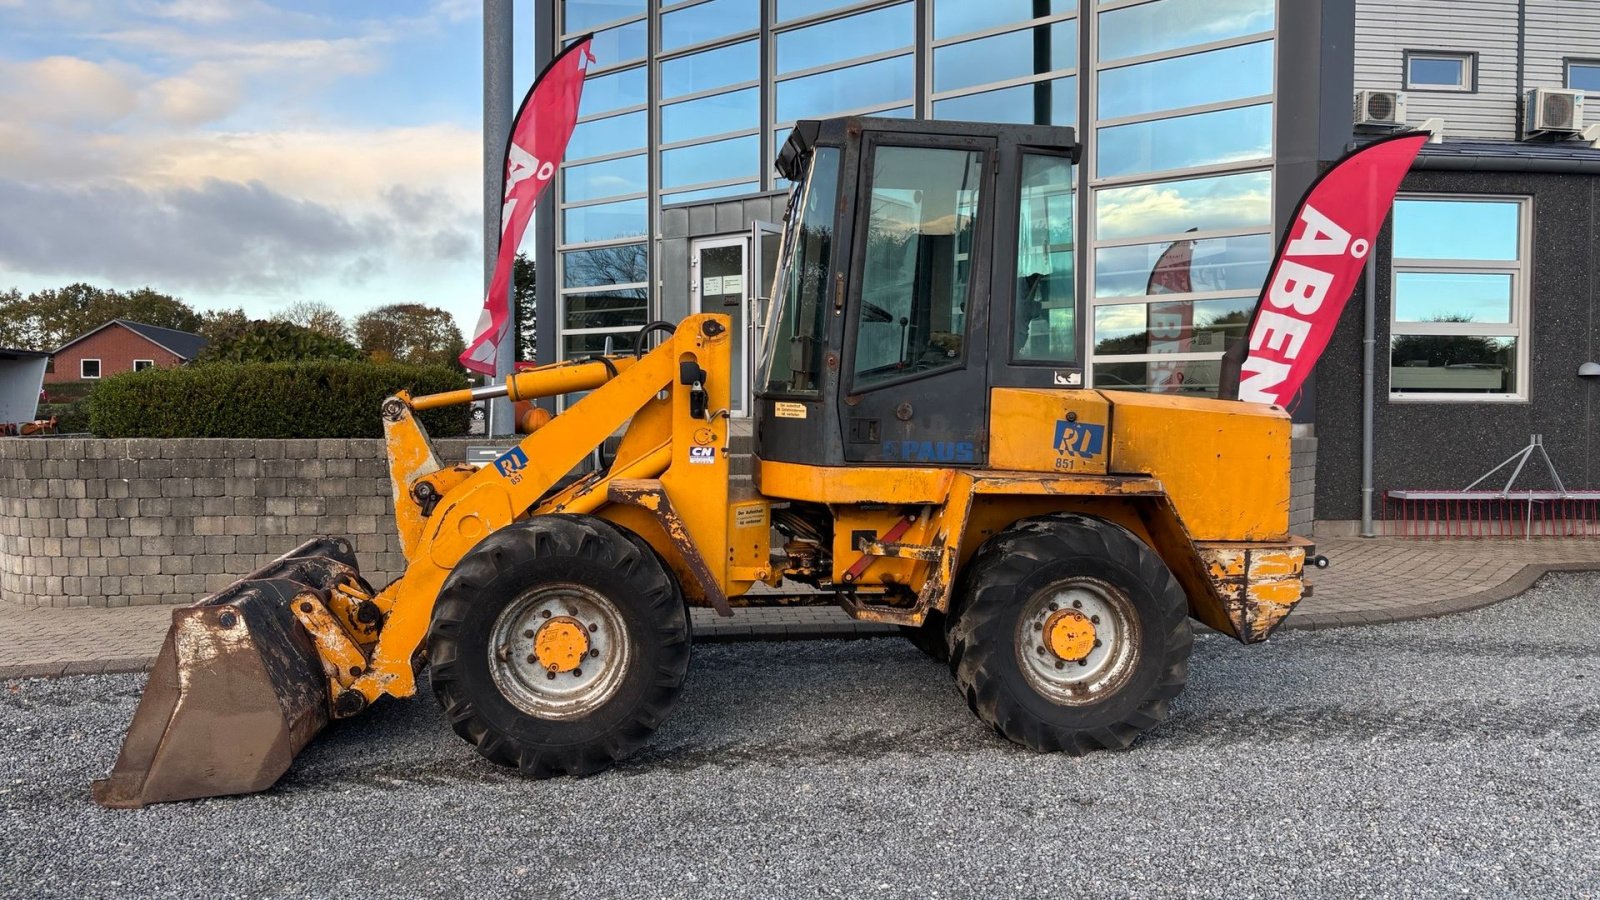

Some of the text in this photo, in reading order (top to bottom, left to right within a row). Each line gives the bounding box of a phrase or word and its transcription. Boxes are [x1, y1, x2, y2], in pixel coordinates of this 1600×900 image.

[1238, 203, 1369, 405] ÅBEN
[691, 447, 713, 456] CN
[901, 441, 974, 463] PAUS
[1055, 457, 1075, 470] 851
[510, 474, 524, 486] 851
